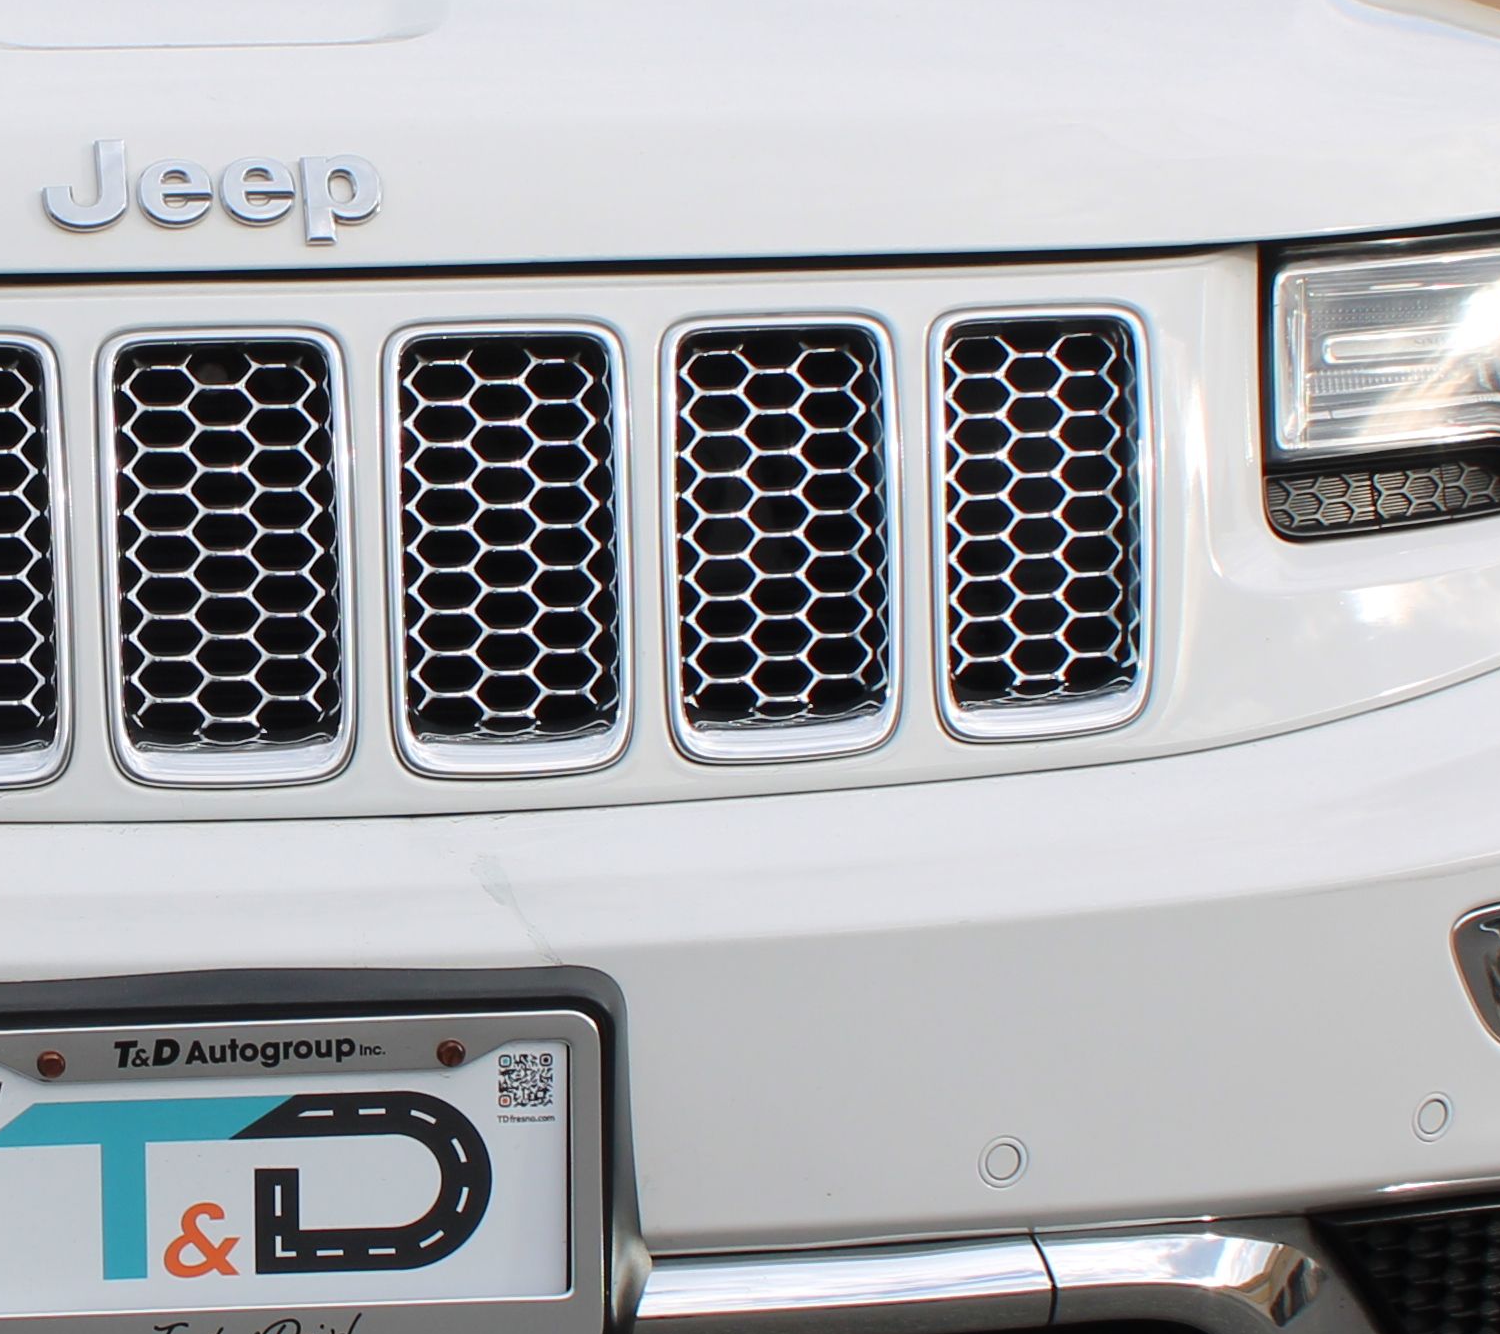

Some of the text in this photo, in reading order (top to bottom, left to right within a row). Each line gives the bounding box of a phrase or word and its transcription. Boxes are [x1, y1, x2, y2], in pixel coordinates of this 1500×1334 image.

[41, 138, 383, 246] Jeep
[114, 1037, 387, 1069] T&D Autogroup Inc.
